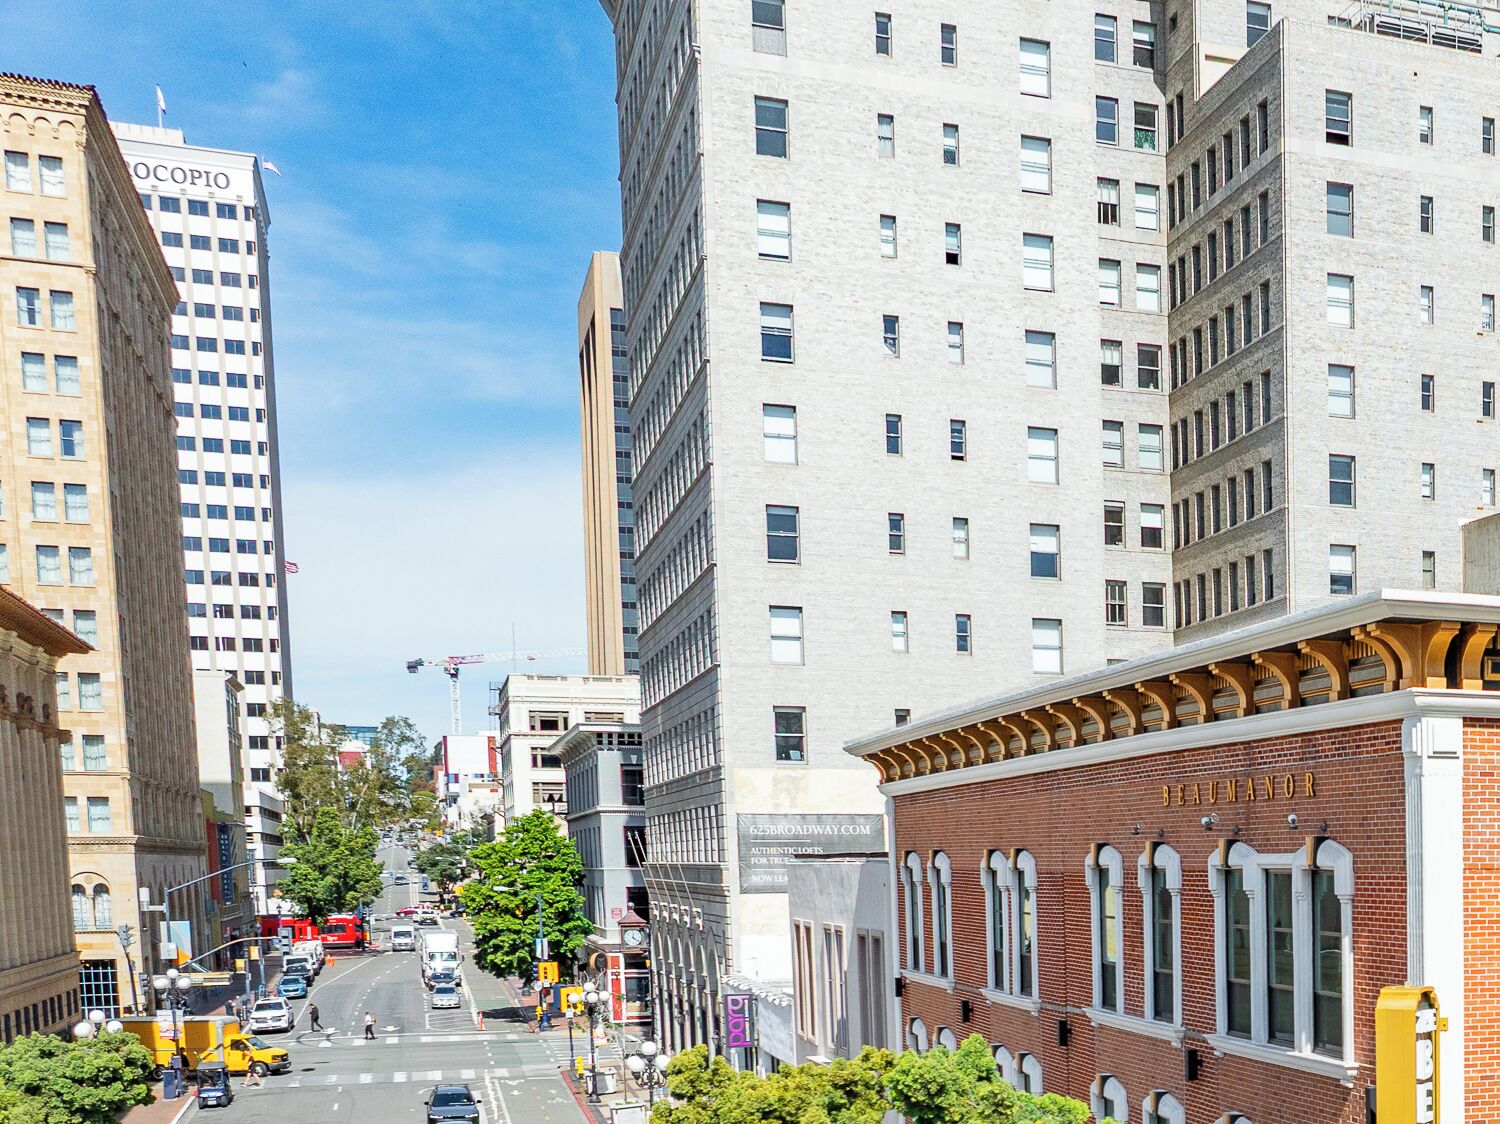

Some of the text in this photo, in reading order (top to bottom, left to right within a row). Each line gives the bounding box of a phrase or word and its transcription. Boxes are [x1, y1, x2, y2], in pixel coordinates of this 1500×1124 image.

[1162, 772, 1316, 807] BEAUMANOR
[750, 824, 871, 835] 625BROADWAY.COM
[751, 847, 798, 855] AUTHENTIC
[751, 857, 768, 865] FOR
[752, 874, 789, 882] NOW LEA
[728, 995, 752, 1046] parq
